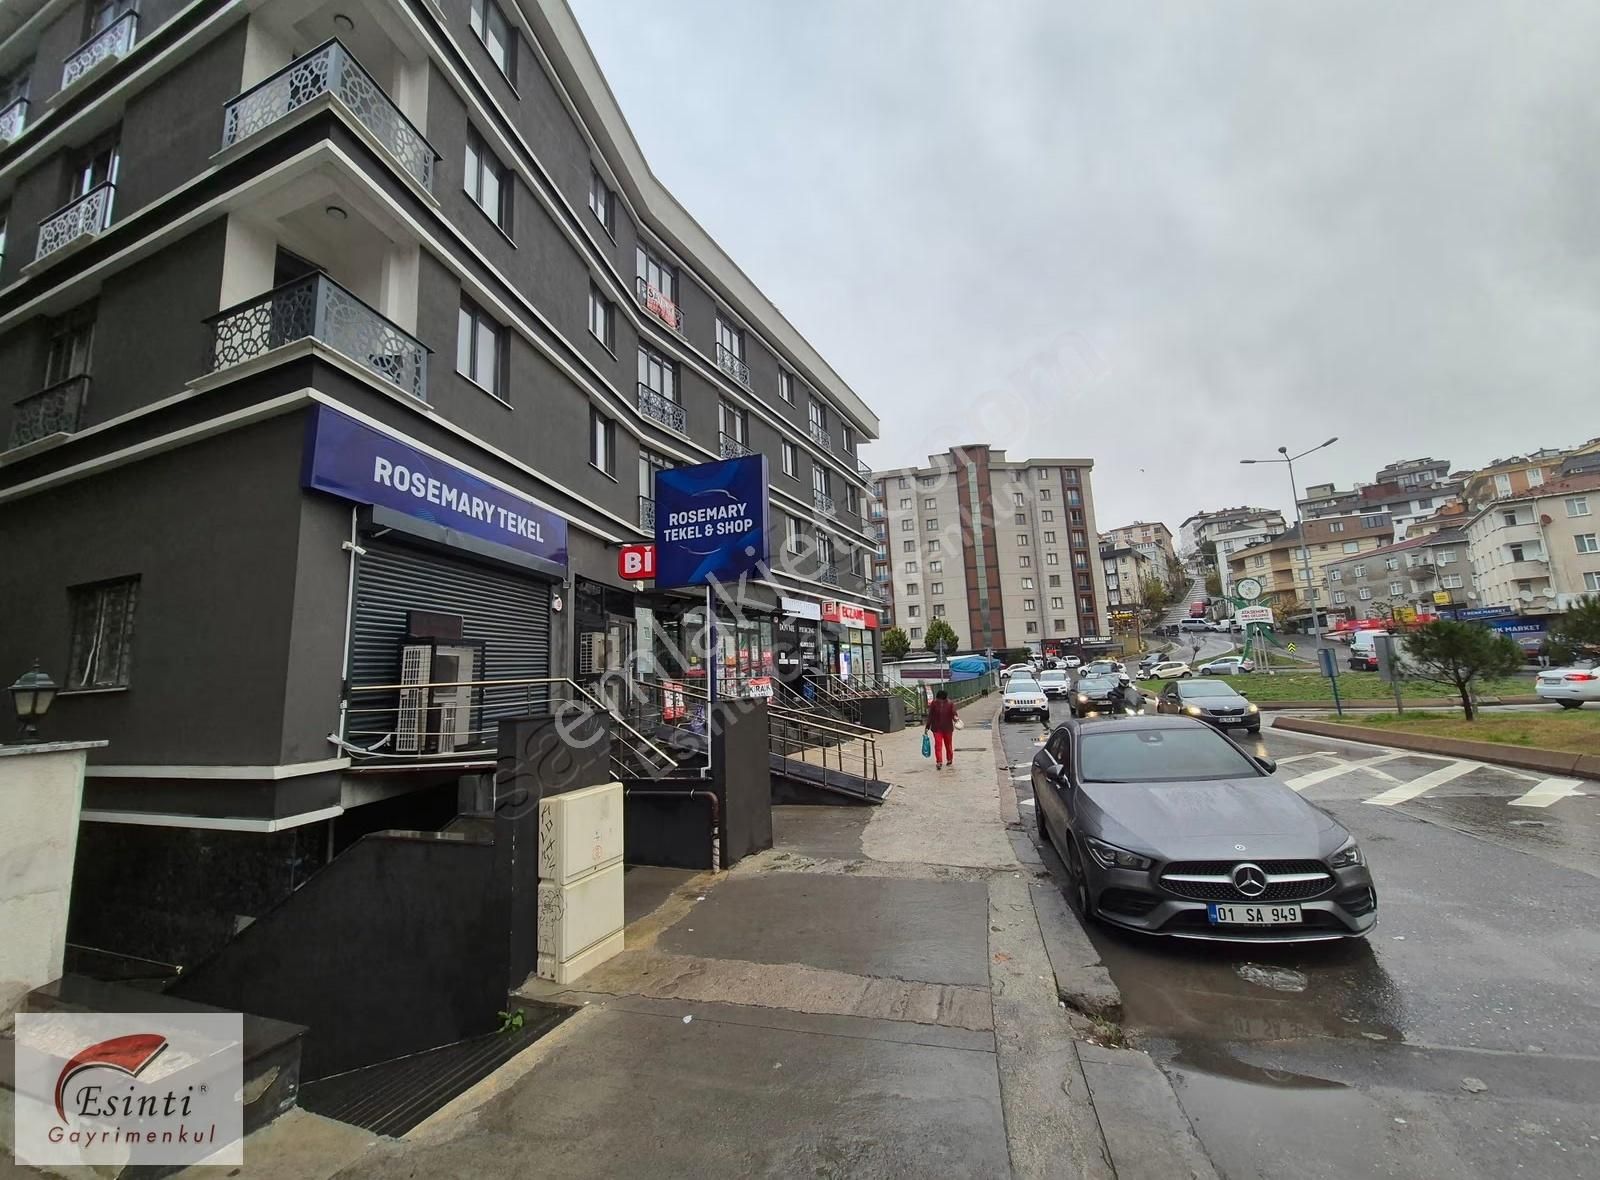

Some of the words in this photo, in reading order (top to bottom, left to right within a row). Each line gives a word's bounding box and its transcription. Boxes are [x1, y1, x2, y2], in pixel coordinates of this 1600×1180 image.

[373, 456, 495, 523] ROSEMARY
[497, 507, 544, 543] TEKEL
[669, 503, 747, 526] ROSEMARY
[663, 526, 702, 542] TEKEL
[704, 524, 713, 537] &
[716, 519, 753, 535] SHOP
[825, 603, 833, 612] E
[1218, 907, 1234, 921] 01
[1246, 908, 1264, 922] SA
[1271, 907, 1297, 922] 949
